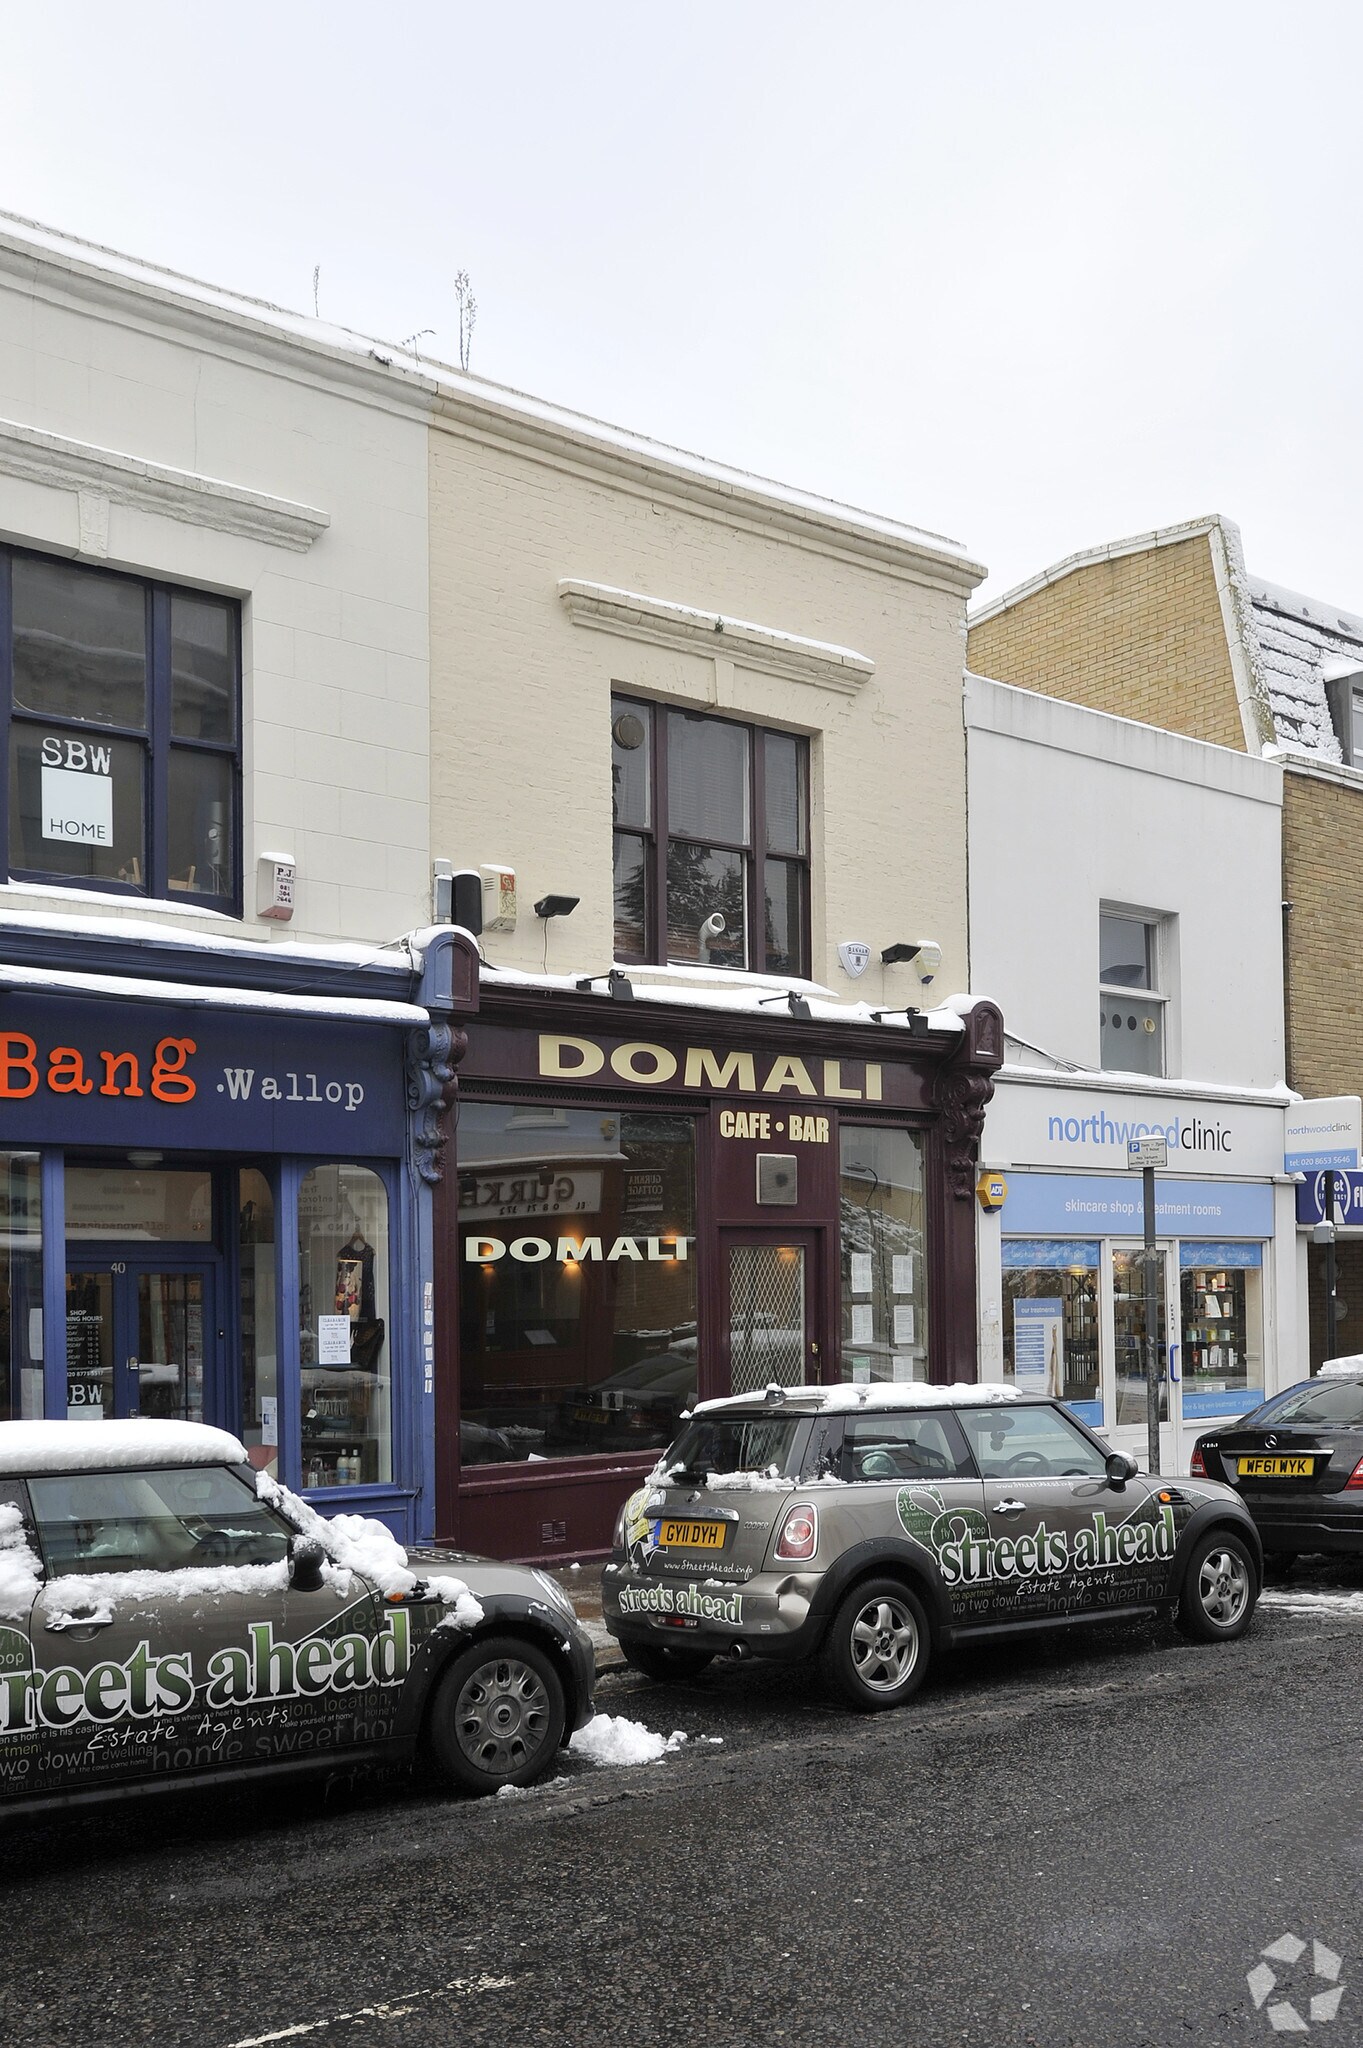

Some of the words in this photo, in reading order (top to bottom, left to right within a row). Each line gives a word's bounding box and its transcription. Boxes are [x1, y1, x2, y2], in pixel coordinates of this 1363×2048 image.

[41, 737, 112, 775] SBW
[50, 818, 106, 840] HOME
[0, 1031, 198, 1104] Bang
[538, 1034, 884, 1102] DOMALI
[719, 1110, 771, 1141] CAFE
[789, 1117, 830, 1144] BAR
[1287, 1122, 1352, 1135] northwoodclinic
[1131, 1143, 1139, 1152] P
[1301, 1158, 1314, 1166] 020
[1315, 1157, 1331, 1165] 8653
[1333, 1156, 1351, 1164] 5646
[991, 1185, 1003, 1195] ADT
[1321, 1177, 1344, 1192] fet
[1065, 1199, 1108, 1213] skincare
[1110, 1200, 1134, 1216] shop
[1137, 1202, 1144, 1213] &
[1155, 1203, 1191, 1215] eatment
[1193, 1206, 1222, 1216] rooms
[465, 1236, 689, 1263] DOMALI
[110, 1262, 126, 1274] 40
[67, 1384, 104, 1405] BW
[1247, 1460, 1276, 1473] WF61
[1280, 1460, 1306, 1473] WYK
[666, 1524, 689, 1544] GY11
[691, 1525, 719, 1544] DYH
[744, 1521, 769, 1530] COOPER
[940, 1528, 951, 1540] fly
[940, 1521, 1069, 1586] streets
[1073, 1505, 1176, 1571] ahead
[1016, 1578, 1061, 1596] Estate
[1068, 1570, 1115, 1601] Agents
[1097, 1583, 1142, 1605] sweet
[618, 1583, 674, 1613] streets
[676, 1583, 743, 1626] ahead
[952, 1602, 966, 1615] up
[969, 1598, 989, 1611] two
[992, 1594, 1021, 1608] down
[0, 1639, 196, 1735] reets
[206, 1607, 410, 1710] ahead
[87, 1721, 179, 1750] Estate
[196, 1705, 289, 1752] Agents
[299, 1715, 327, 1727] yourself
[335, 1712, 354, 1720] home
[49, 1729, 58, 1738] is
[59, 1727, 73, 1736] his
[101, 1744, 153, 1761] dwelling
[153, 1741, 243, 1771] home
[254, 1720, 345, 1757] sweet
[0, 1758, 30, 1777] wo
[38, 1750, 95, 1771] down
